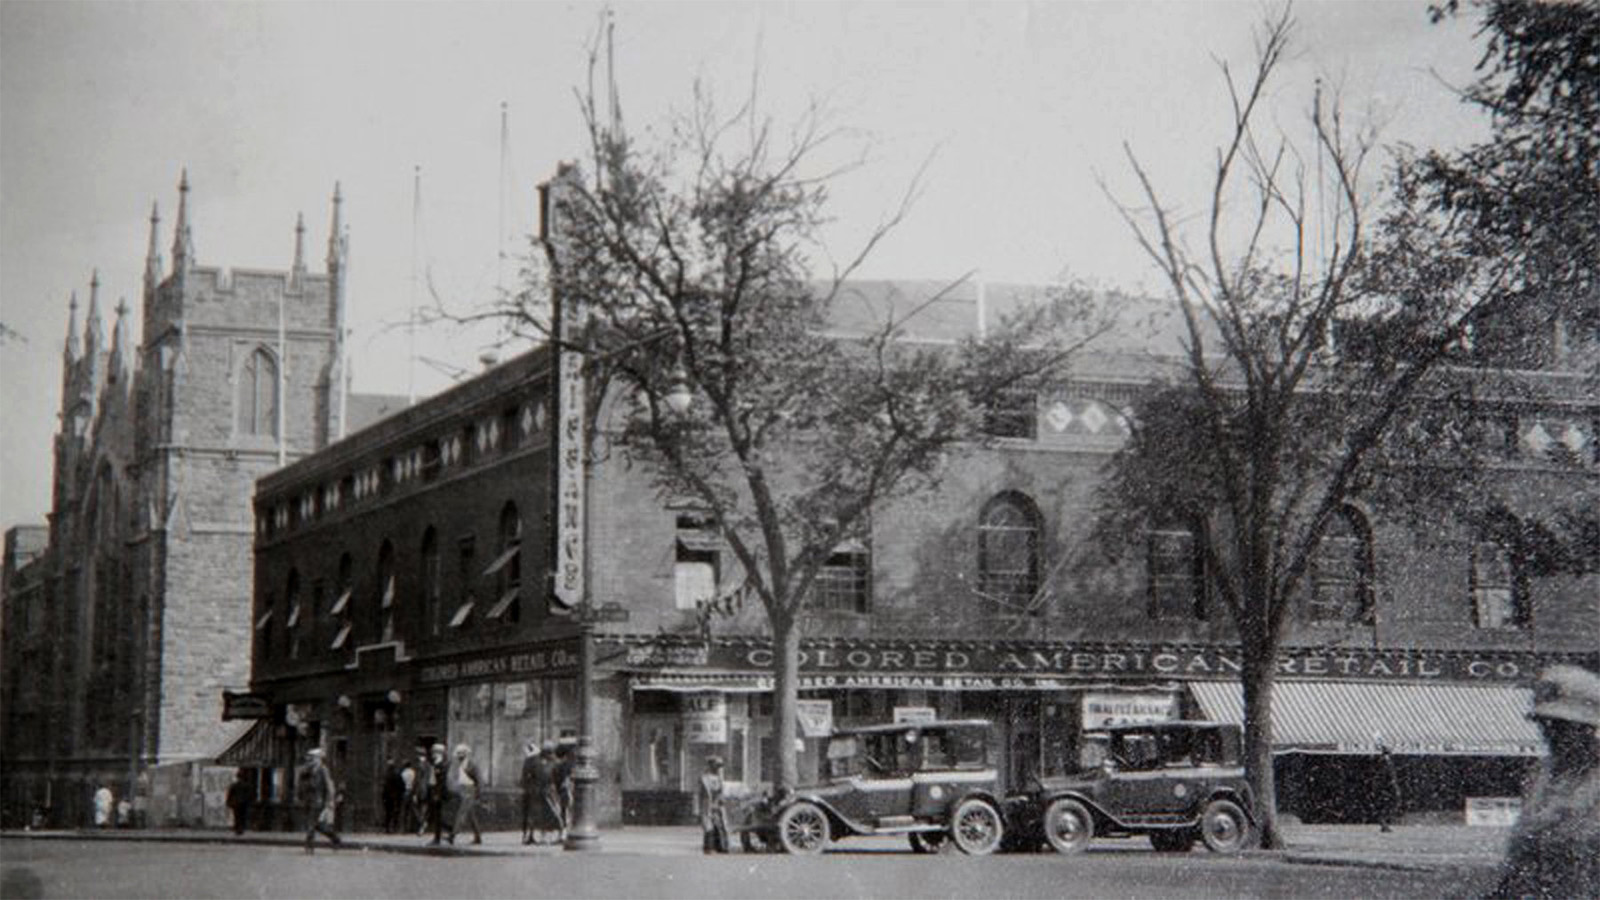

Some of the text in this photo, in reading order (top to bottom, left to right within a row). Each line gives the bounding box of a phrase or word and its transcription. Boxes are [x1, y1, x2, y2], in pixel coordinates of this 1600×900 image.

[999, 651, 1242, 672] AMERICAN
[1275, 656, 1441, 676] RETAIL
[845, 677, 936, 688] AMERICAN
[943, 678, 996, 688] RETAIL
